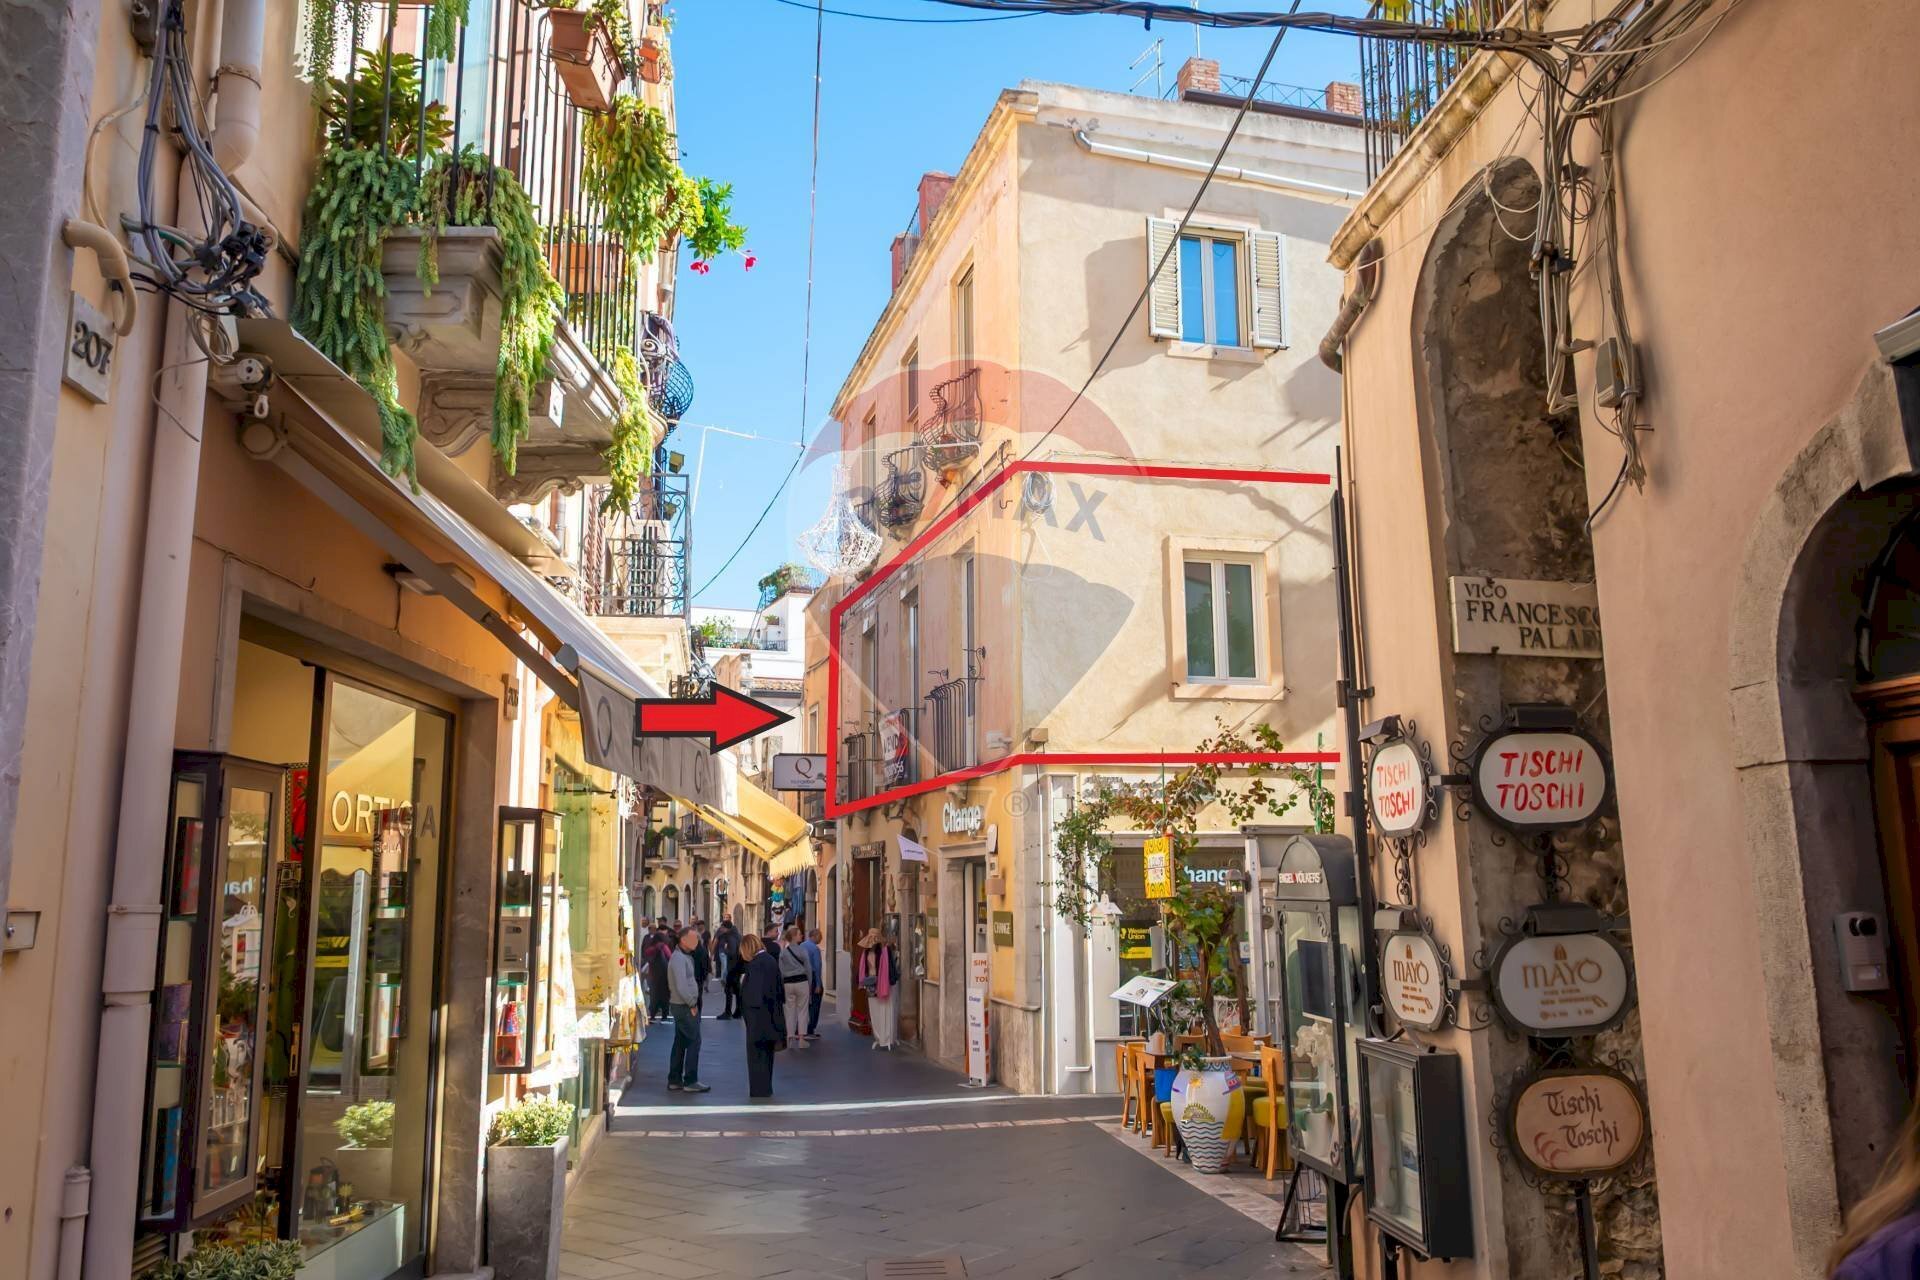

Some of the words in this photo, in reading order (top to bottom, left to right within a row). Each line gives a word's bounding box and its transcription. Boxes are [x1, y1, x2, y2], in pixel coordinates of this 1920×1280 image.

[71, 320, 113, 375] 207
[1464, 583, 1508, 598] VICO
[795, 757, 812, 779] Q
[1377, 760, 1411, 788] TISCHI
[1498, 748, 1583, 778] TISCHI
[1379, 786, 1415, 818] TOSCHI
[1496, 782, 1584, 812] TOSCHI
[331, 790, 437, 839] ORTIGA
[942, 801, 982, 835] Change
[1183, 865, 1228, 886] hang
[1541, 1085, 1603, 1125] Tischi
[1558, 1120, 1620, 1156] Toschi
